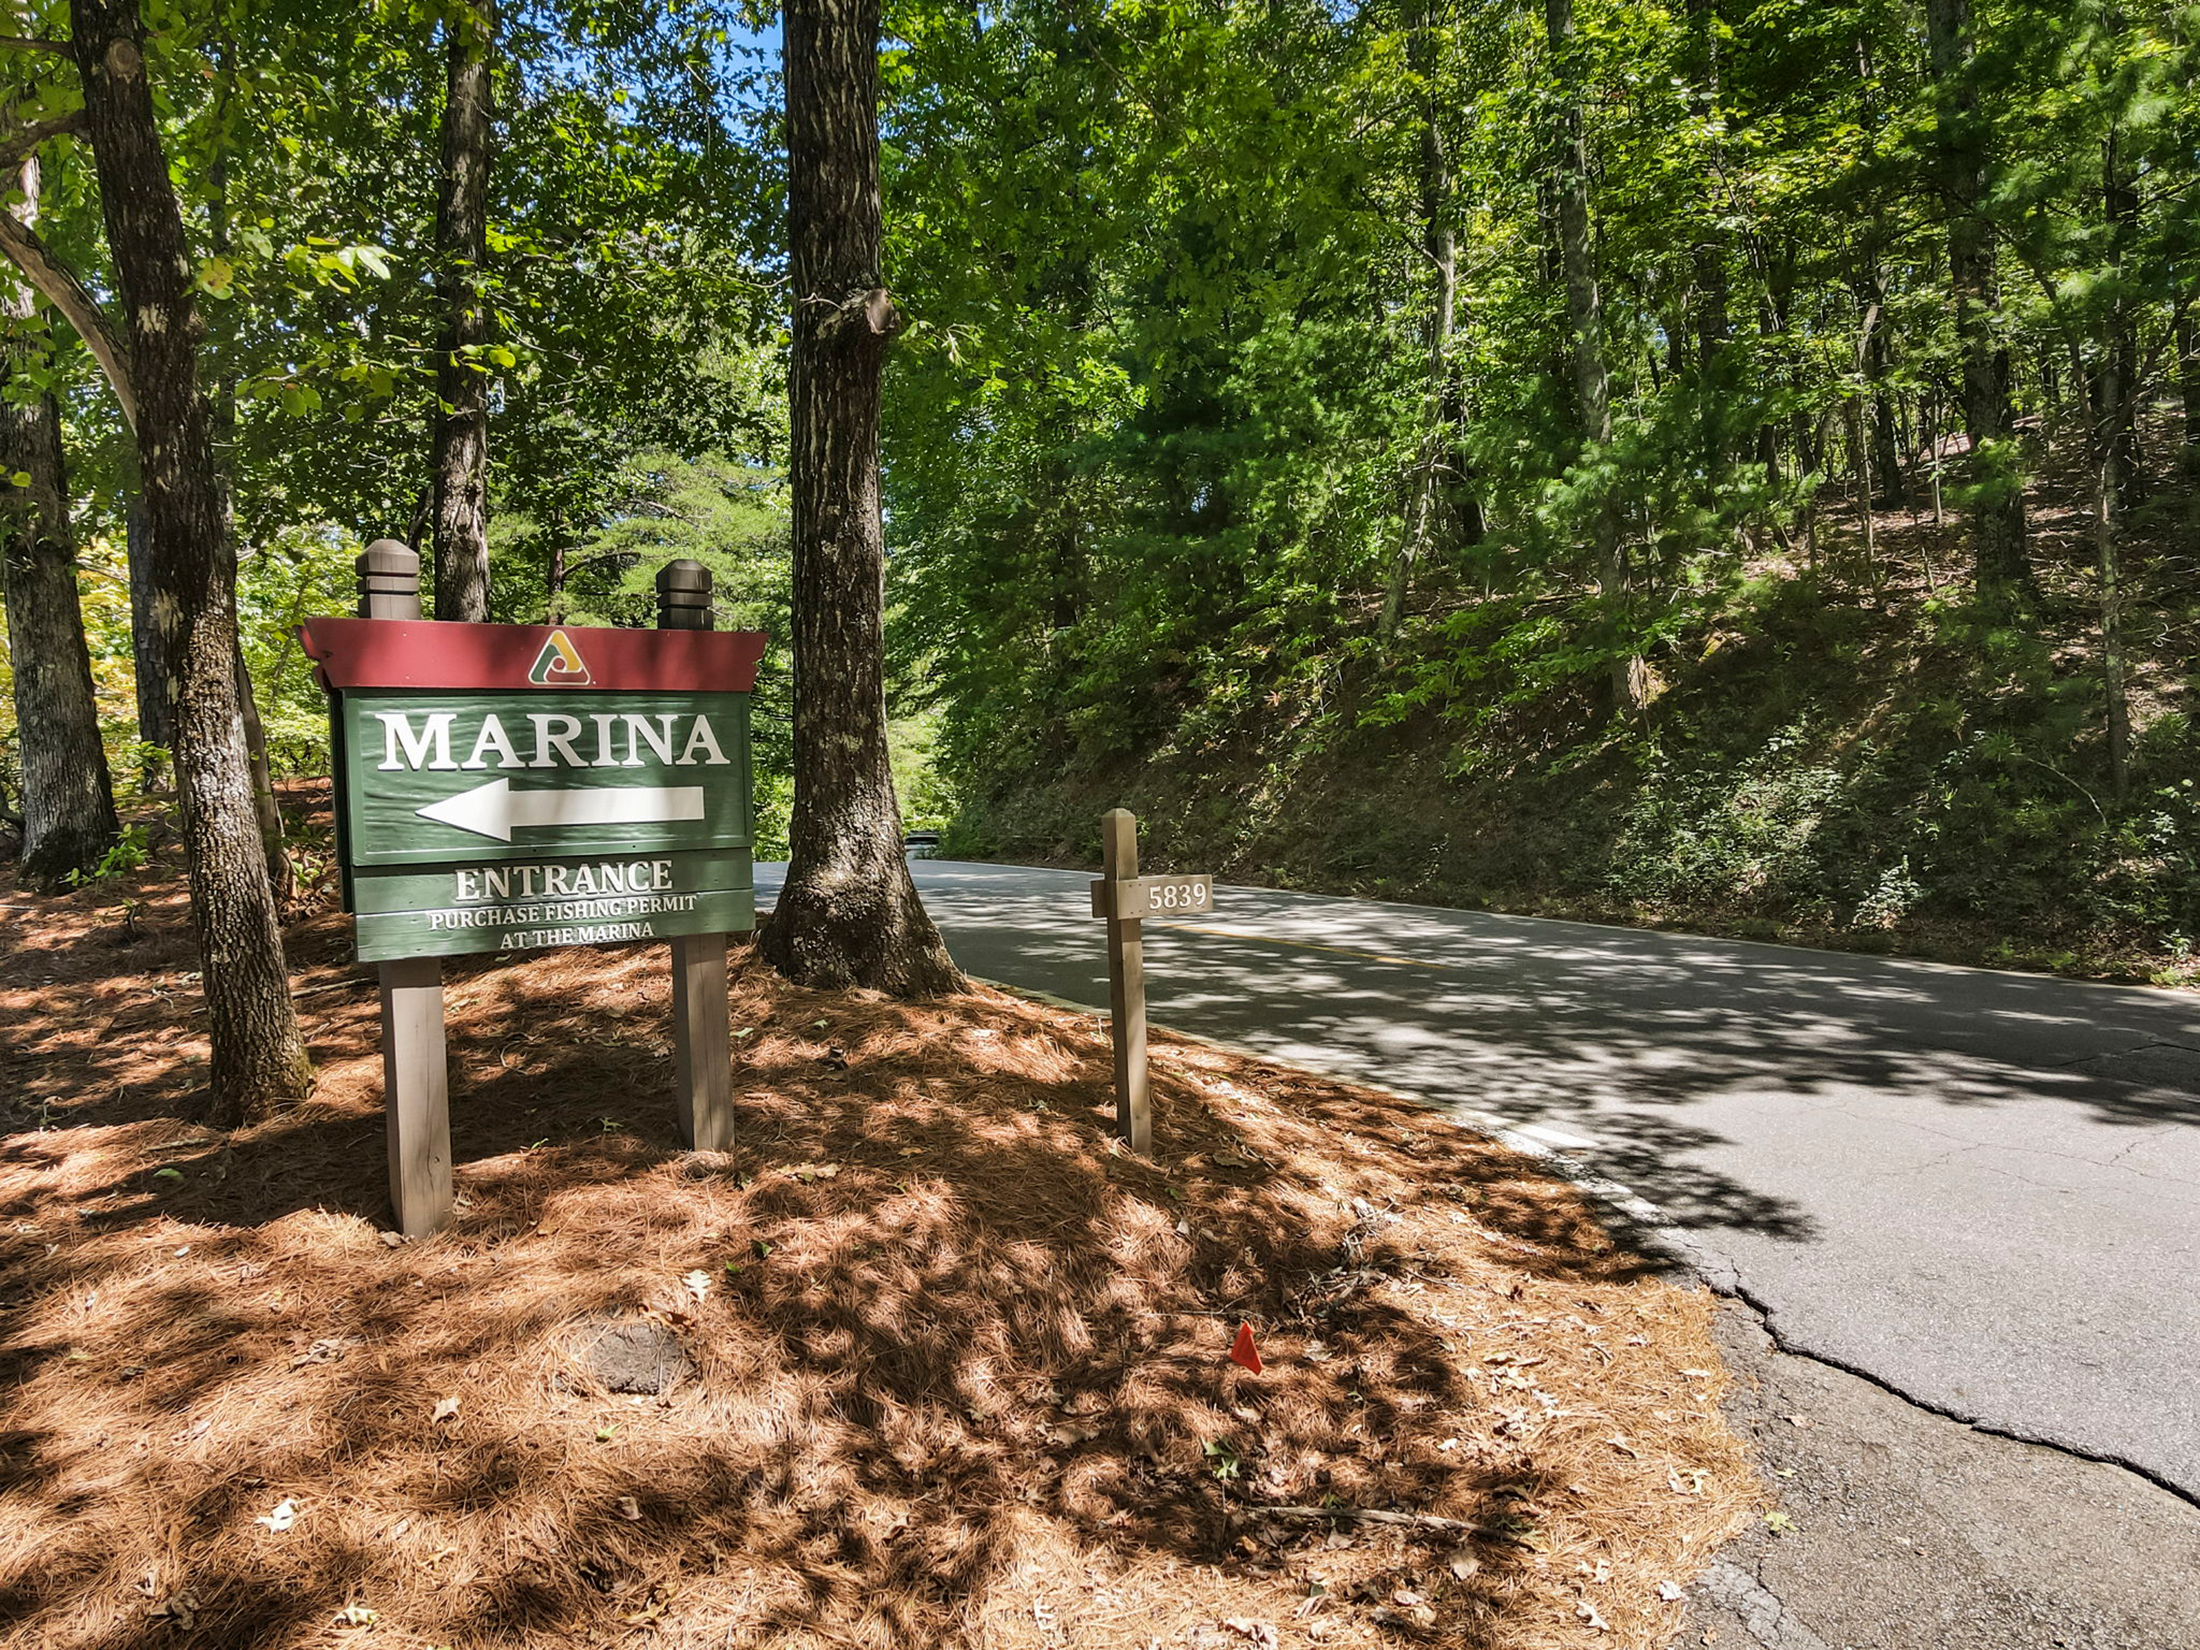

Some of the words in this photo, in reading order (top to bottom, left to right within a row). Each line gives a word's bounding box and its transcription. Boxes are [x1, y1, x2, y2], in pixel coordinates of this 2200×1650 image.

[374, 713, 731, 771] MARINA
[455, 860, 673, 901] ENTRANCE
[1149, 883, 1207, 909] 5839
[430, 906, 539, 931] PURCHASE
[545, 901, 621, 922] FISHING
[627, 894, 697, 915] PERMIT
[500, 933, 529, 950] AT
[534, 930, 575, 947] THE
[577, 922, 654, 944] MARINA
